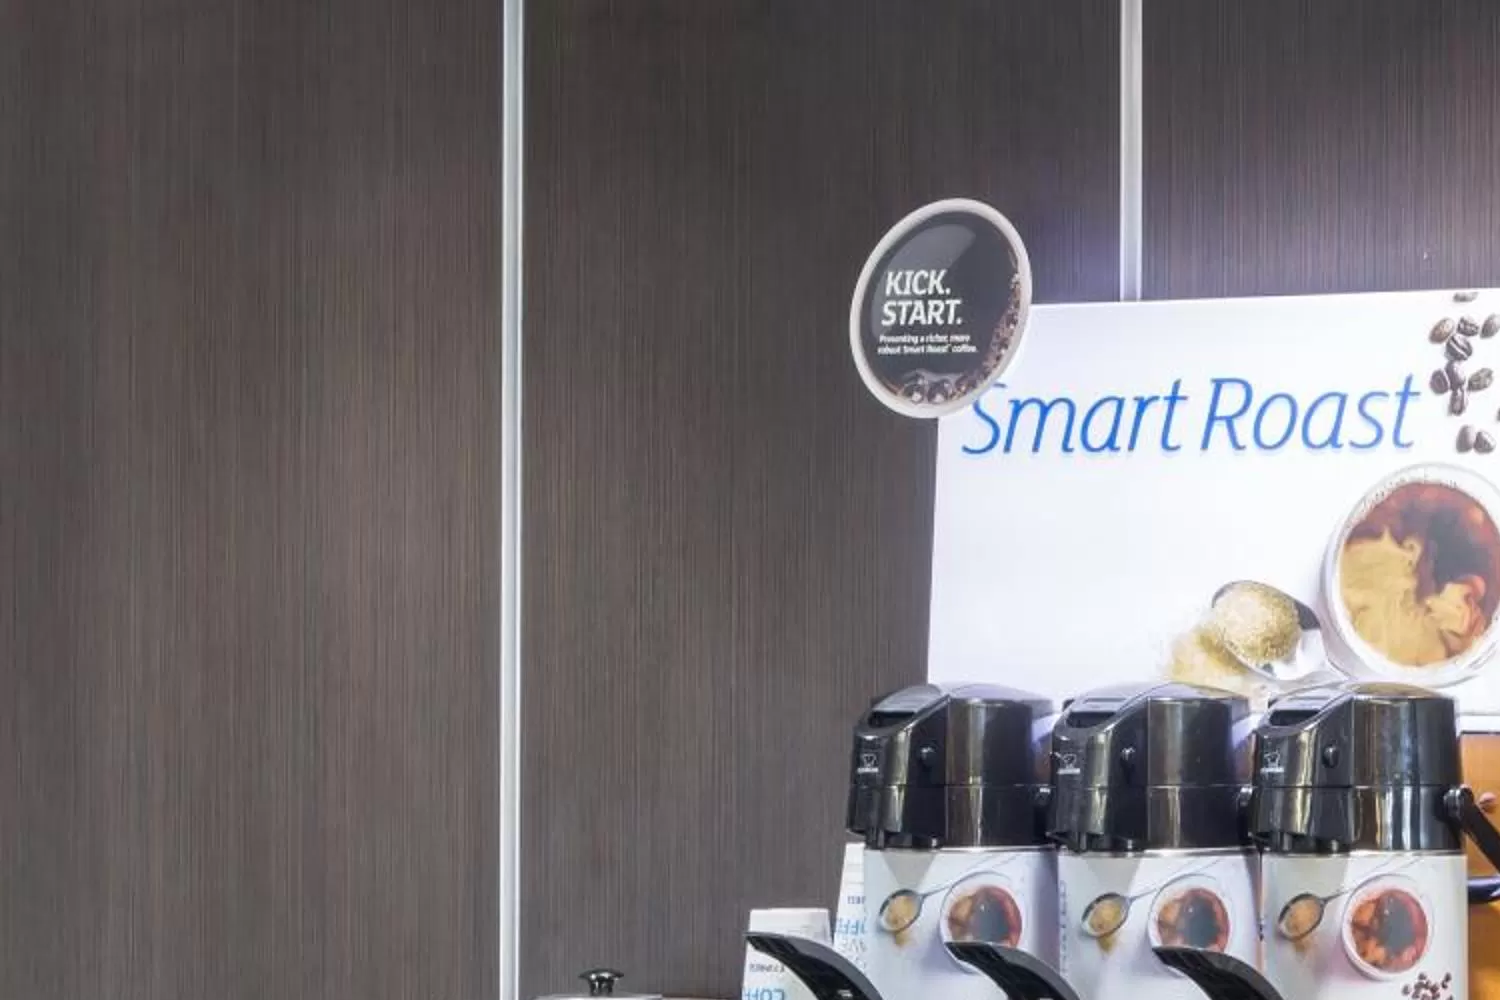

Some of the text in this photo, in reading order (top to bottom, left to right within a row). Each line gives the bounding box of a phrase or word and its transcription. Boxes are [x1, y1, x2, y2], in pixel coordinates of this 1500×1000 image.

[885, 268, 951, 297] KICK.
[881, 299, 963, 327] START.
[961, 373, 1421, 455] Smart Roast
